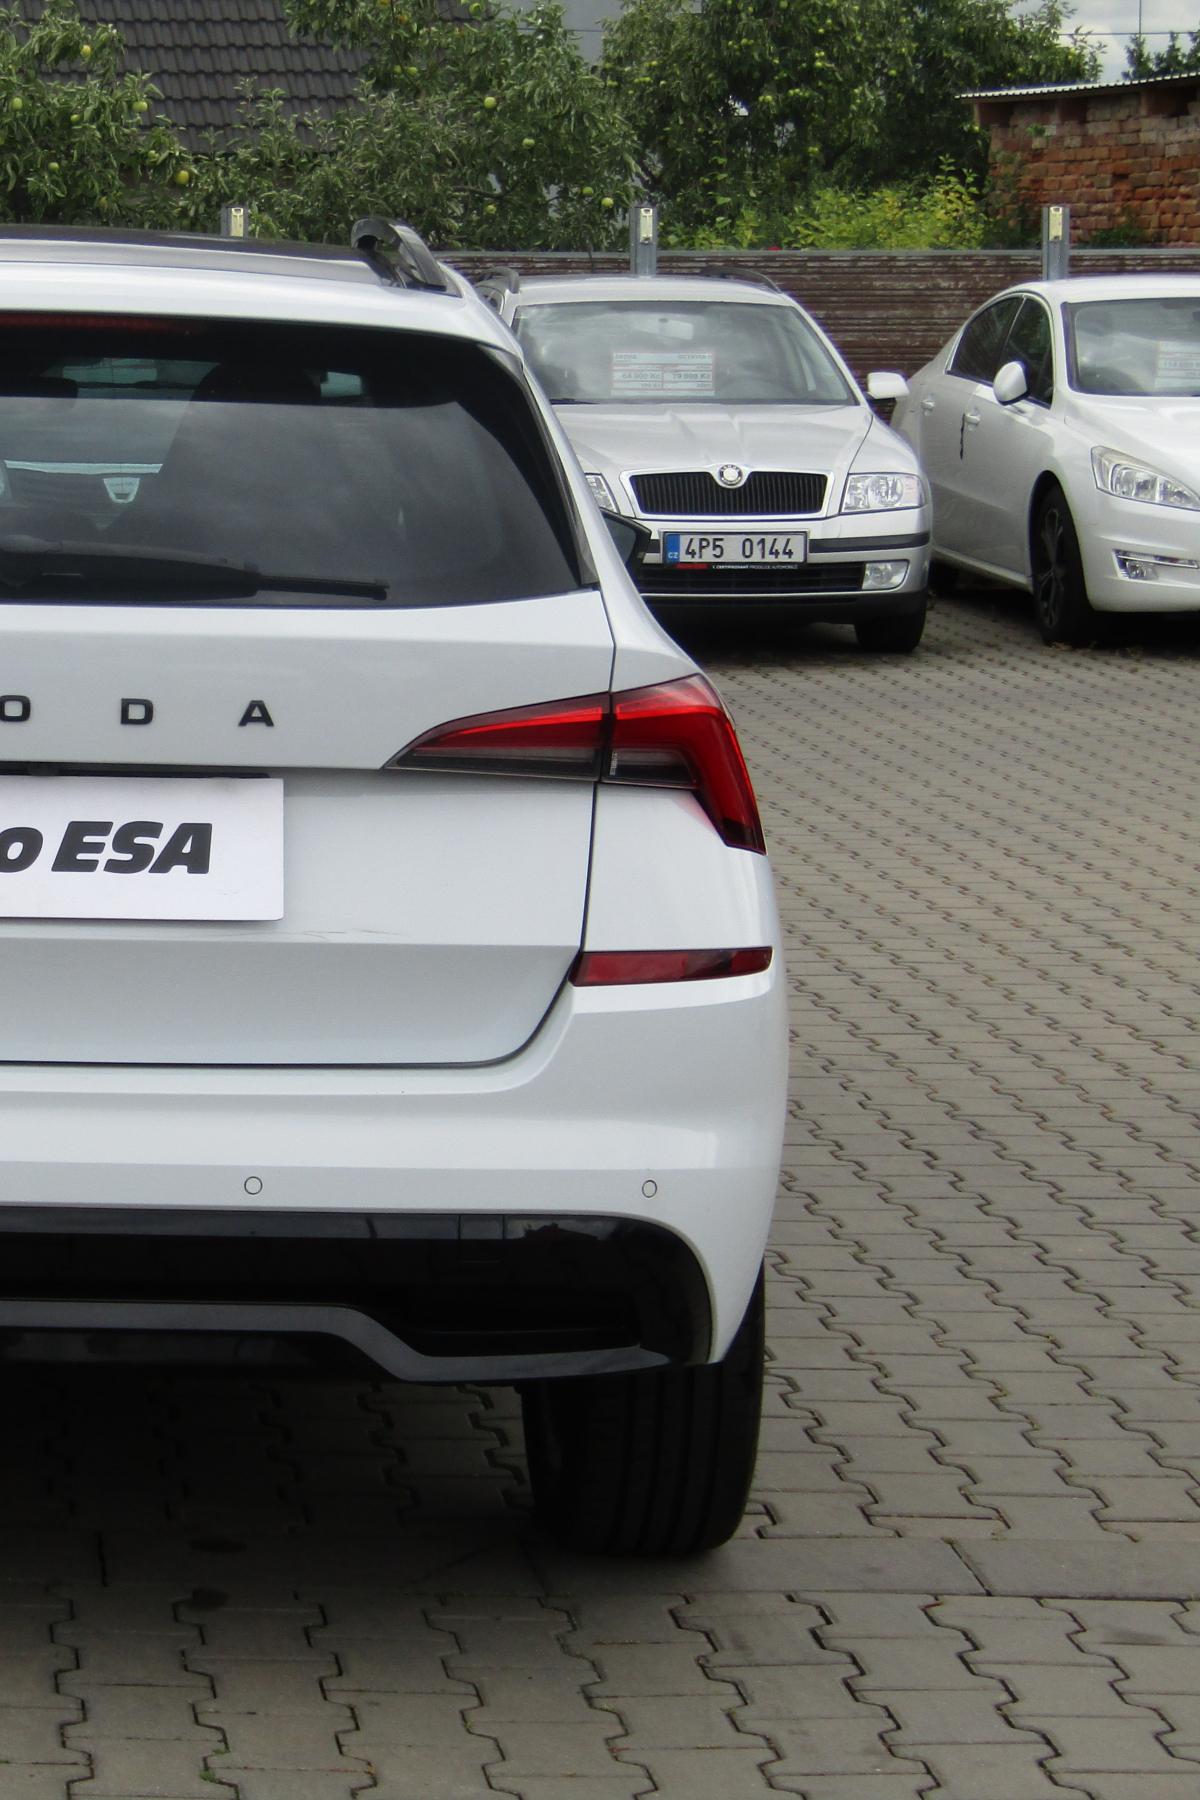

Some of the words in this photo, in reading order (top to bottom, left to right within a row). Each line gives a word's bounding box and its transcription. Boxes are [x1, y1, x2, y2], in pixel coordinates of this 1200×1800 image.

[668, 551, 679, 559] CZ
[685, 537, 724, 559] 4P5
[742, 537, 794, 559] 0144
[51, 821, 213, 875] ESA
